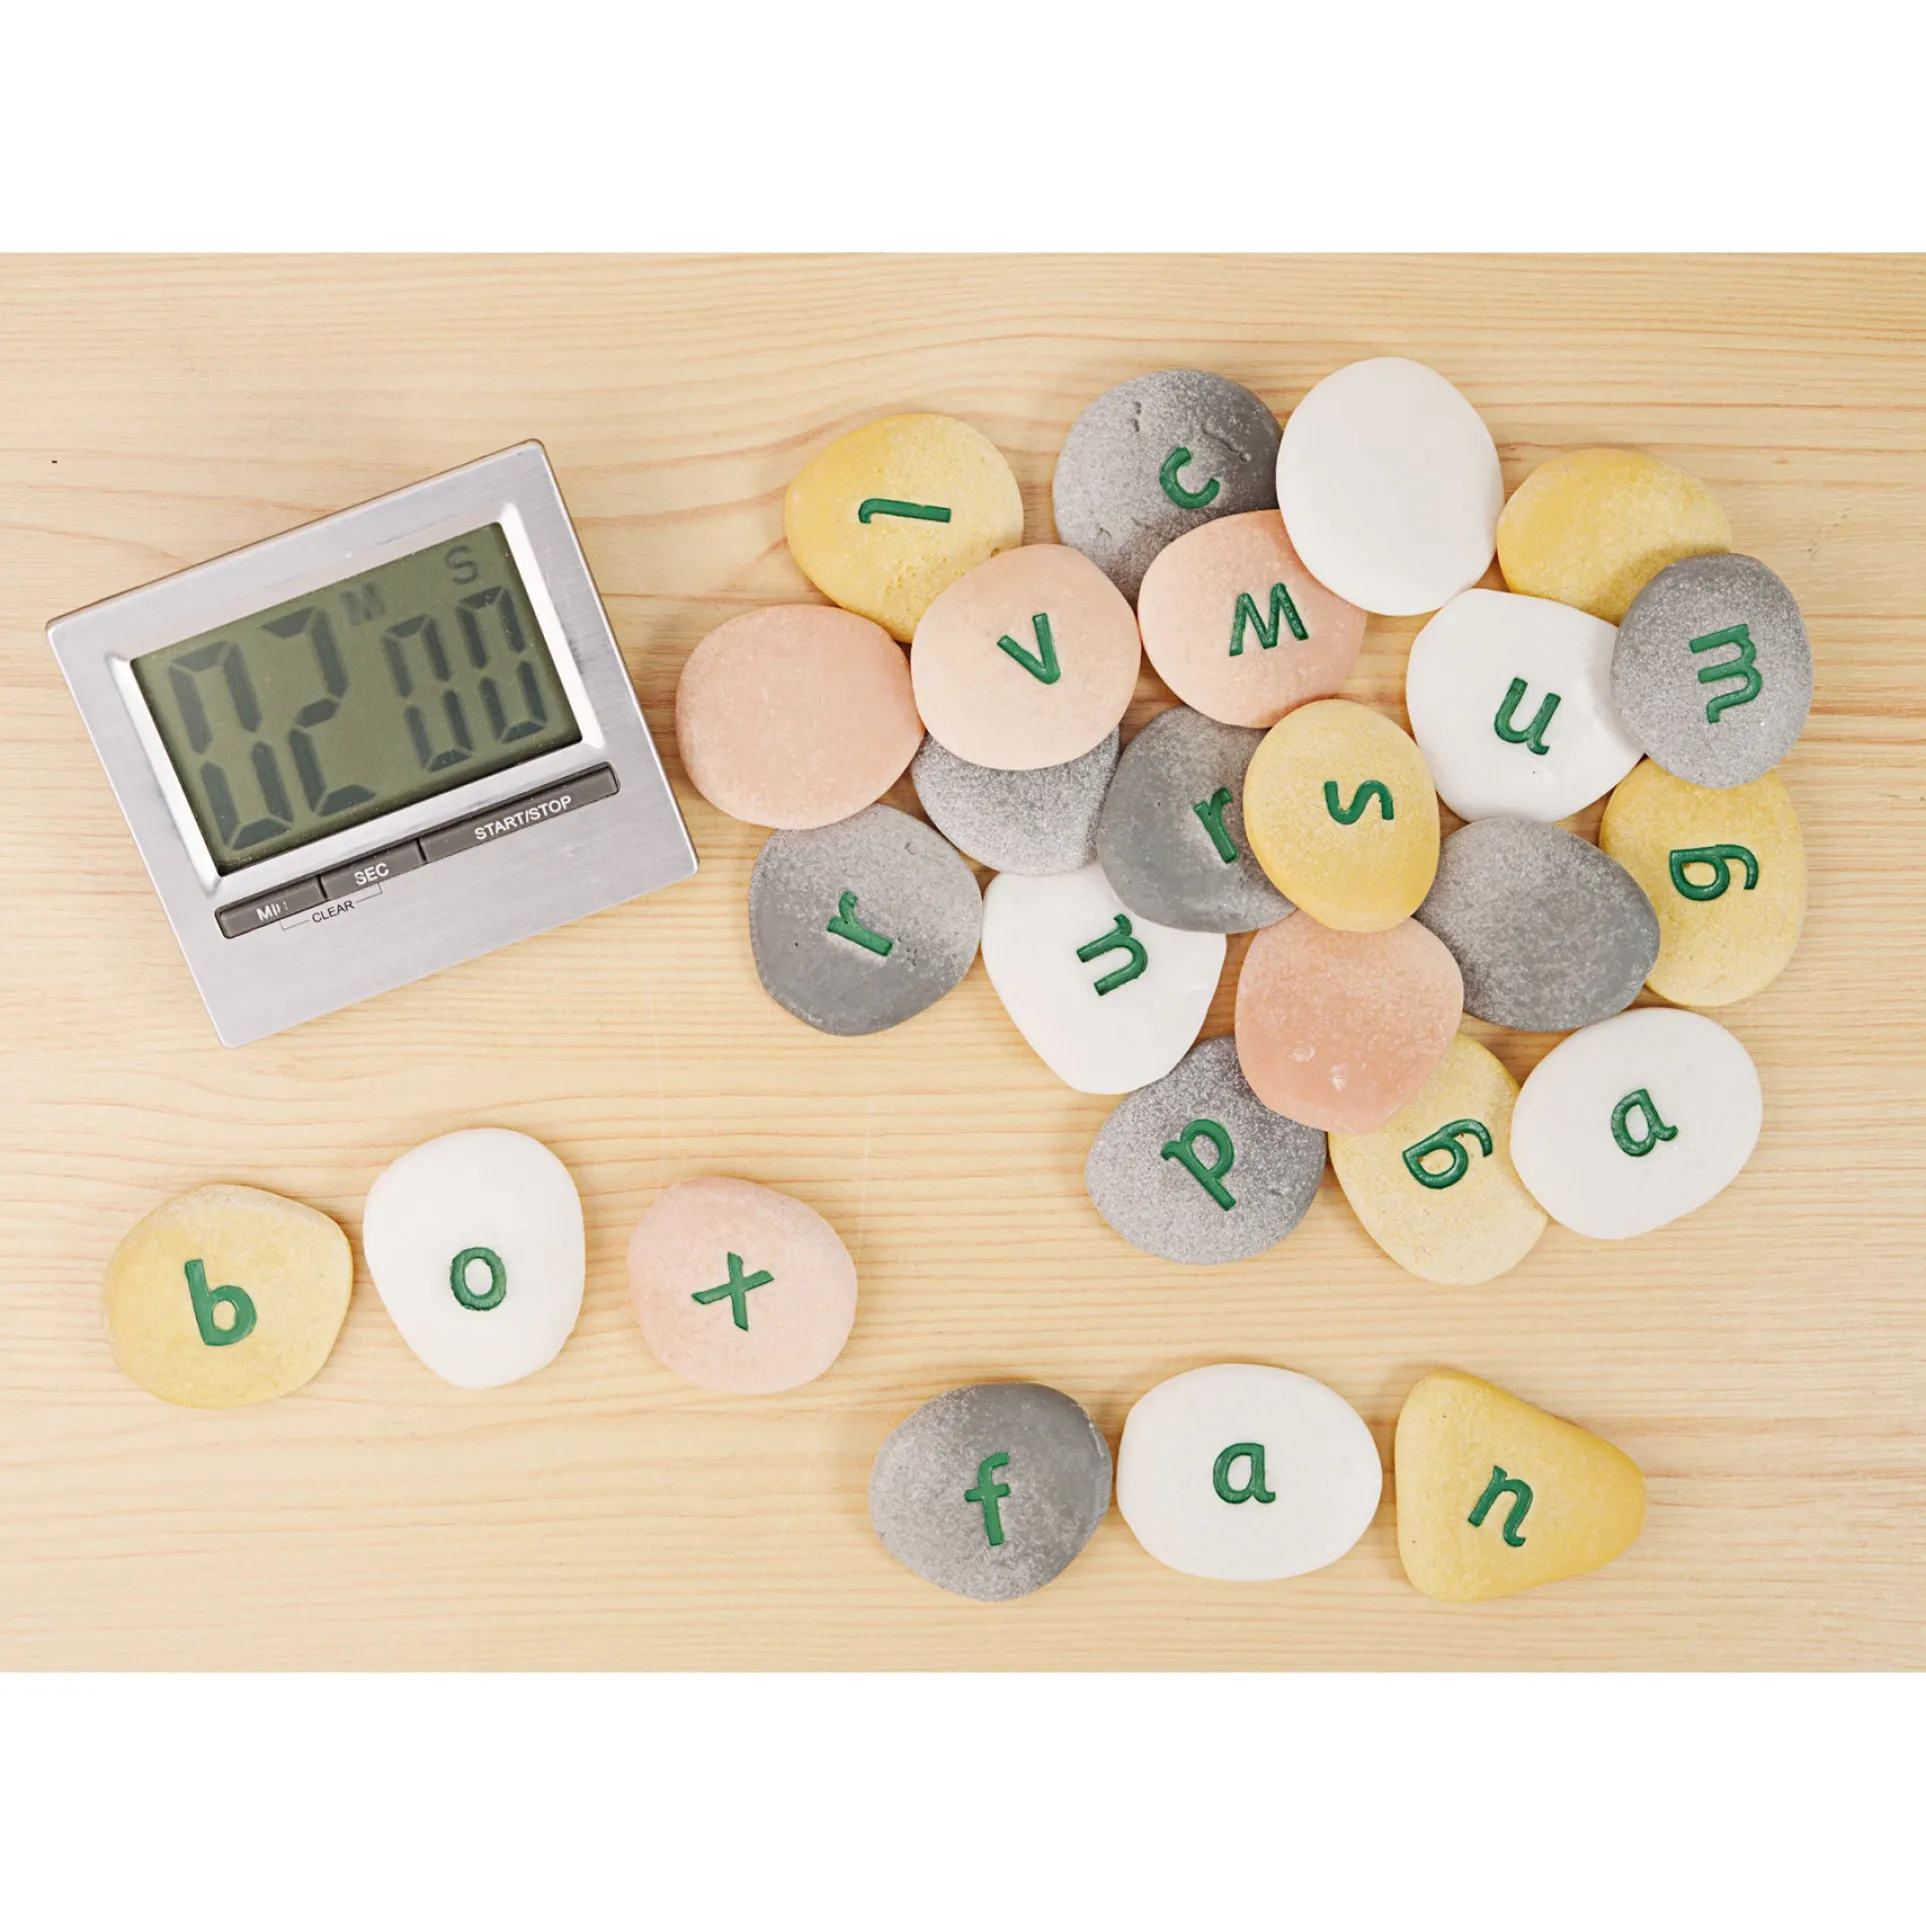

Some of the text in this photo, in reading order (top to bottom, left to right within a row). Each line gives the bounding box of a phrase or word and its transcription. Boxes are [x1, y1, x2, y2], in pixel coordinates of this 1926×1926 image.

[1159, 447, 1220, 510] c
[446, 545, 479, 585] S
[997, 612, 1060, 685] v
[1689, 623, 1763, 724] m
[473, 796, 573, 840] START/STOP
[1193, 787, 1238, 864] r
[355, 863, 390, 886] SEC
[312, 900, 355, 923] CLEAR
[827, 891, 893, 957] r
[1611, 1088, 1679, 1158] a
